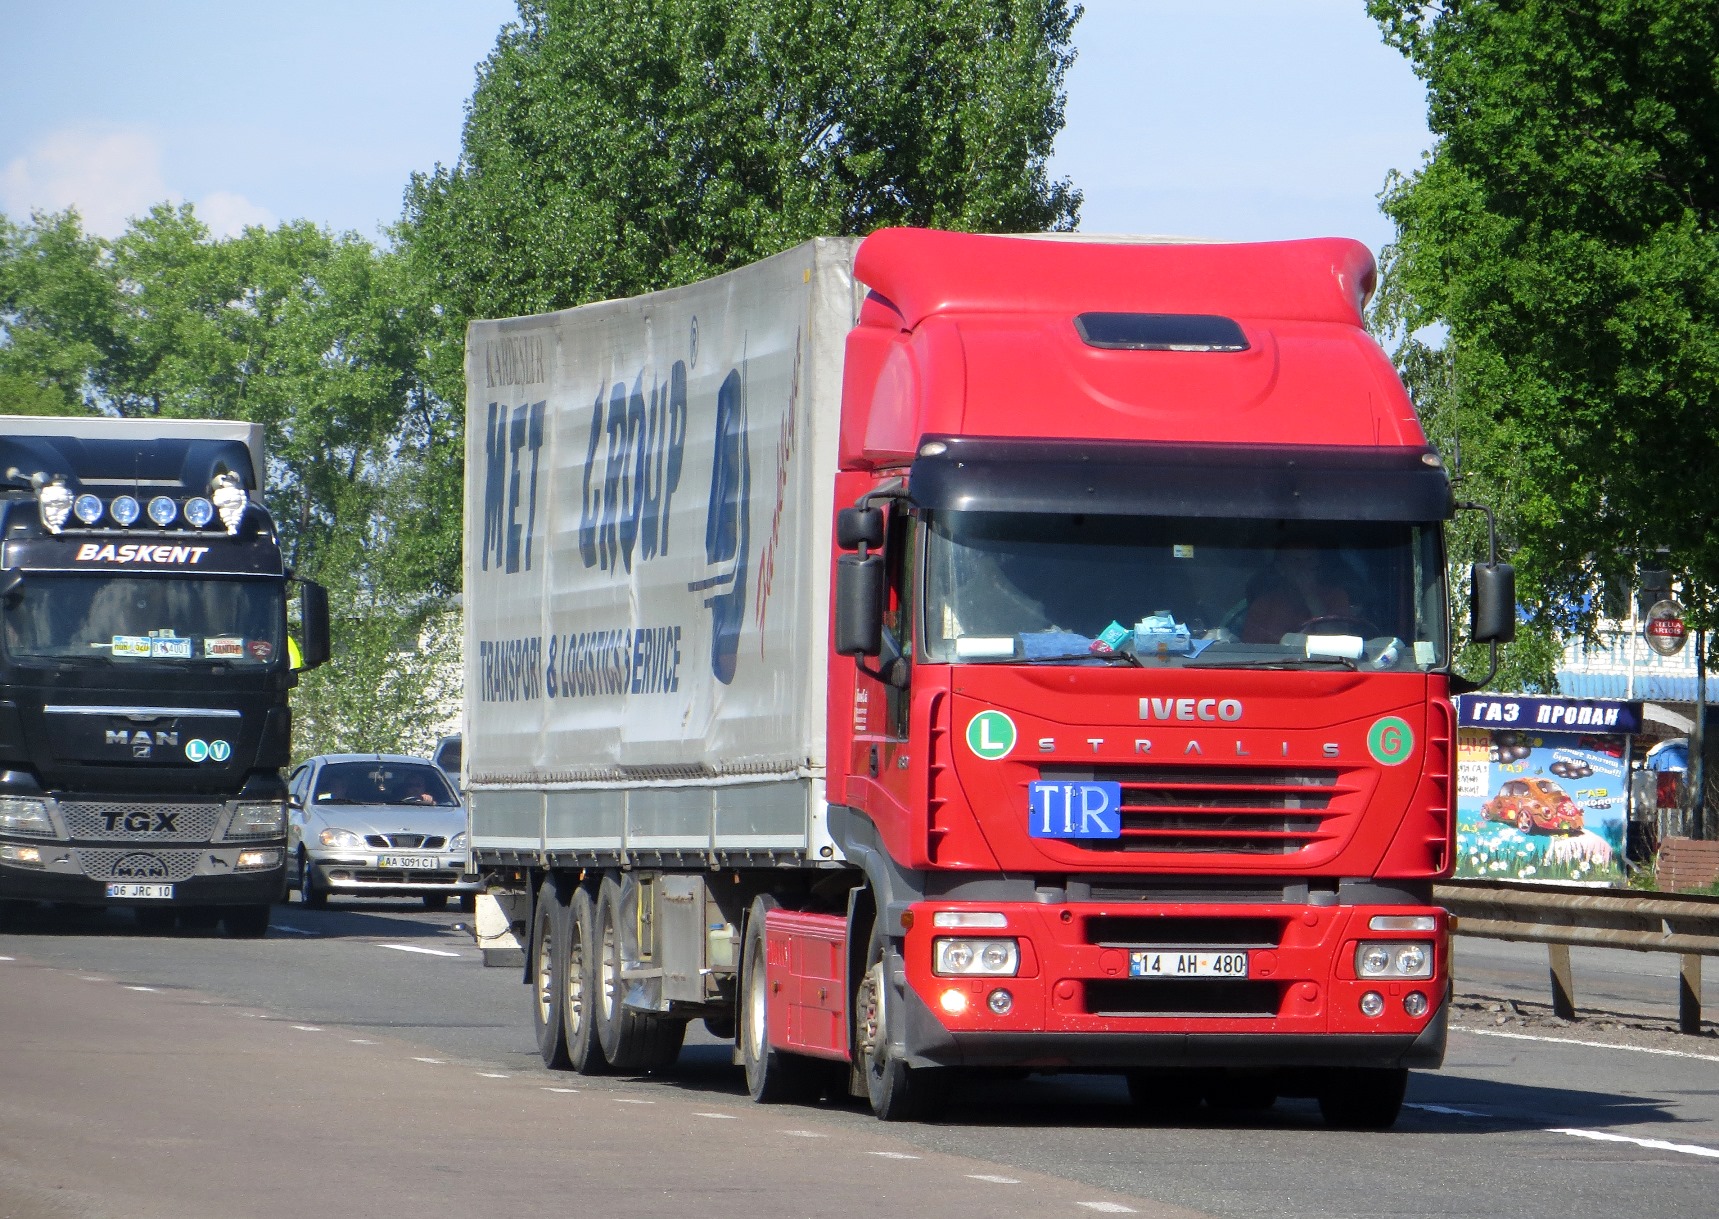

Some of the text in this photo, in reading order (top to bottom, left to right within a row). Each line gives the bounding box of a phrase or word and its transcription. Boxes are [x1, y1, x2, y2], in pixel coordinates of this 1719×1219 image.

[482, 400, 546, 574] MET
[579, 360, 688, 579] GROUP
[76, 543, 209, 564] BAŞKENT
[1653, 627, 1681, 635] ARTOIS
[1654, 620, 1681, 628] STELLA
[480, 626, 681, 702] TRANSPORT & LOGISTICS SERVICE
[1138, 697, 1243, 722] IVECO
[1473, 702, 1620, 726] ГАЗ ПРОПАН
[105, 730, 178, 745] MAN
[979, 718, 1004, 750] L
[1379, 726, 1402, 756] G
[190, 743, 203, 758] L
[213, 744, 225, 757] V
[1038, 737, 1341, 759] STRALIS
[1034, 785, 1113, 834] TIR
[100, 812, 182, 832] TGX
[385, 856, 397, 867] AA
[401, 856, 420, 867] 3091
[117, 867, 162, 877] MAN
[113, 886, 126, 896] 06
[159, 886, 170, 896] 10
[1143, 955, 1160, 972] 14
[1177, 955, 1197, 973] AH
[1213, 955, 1243, 973] 480
